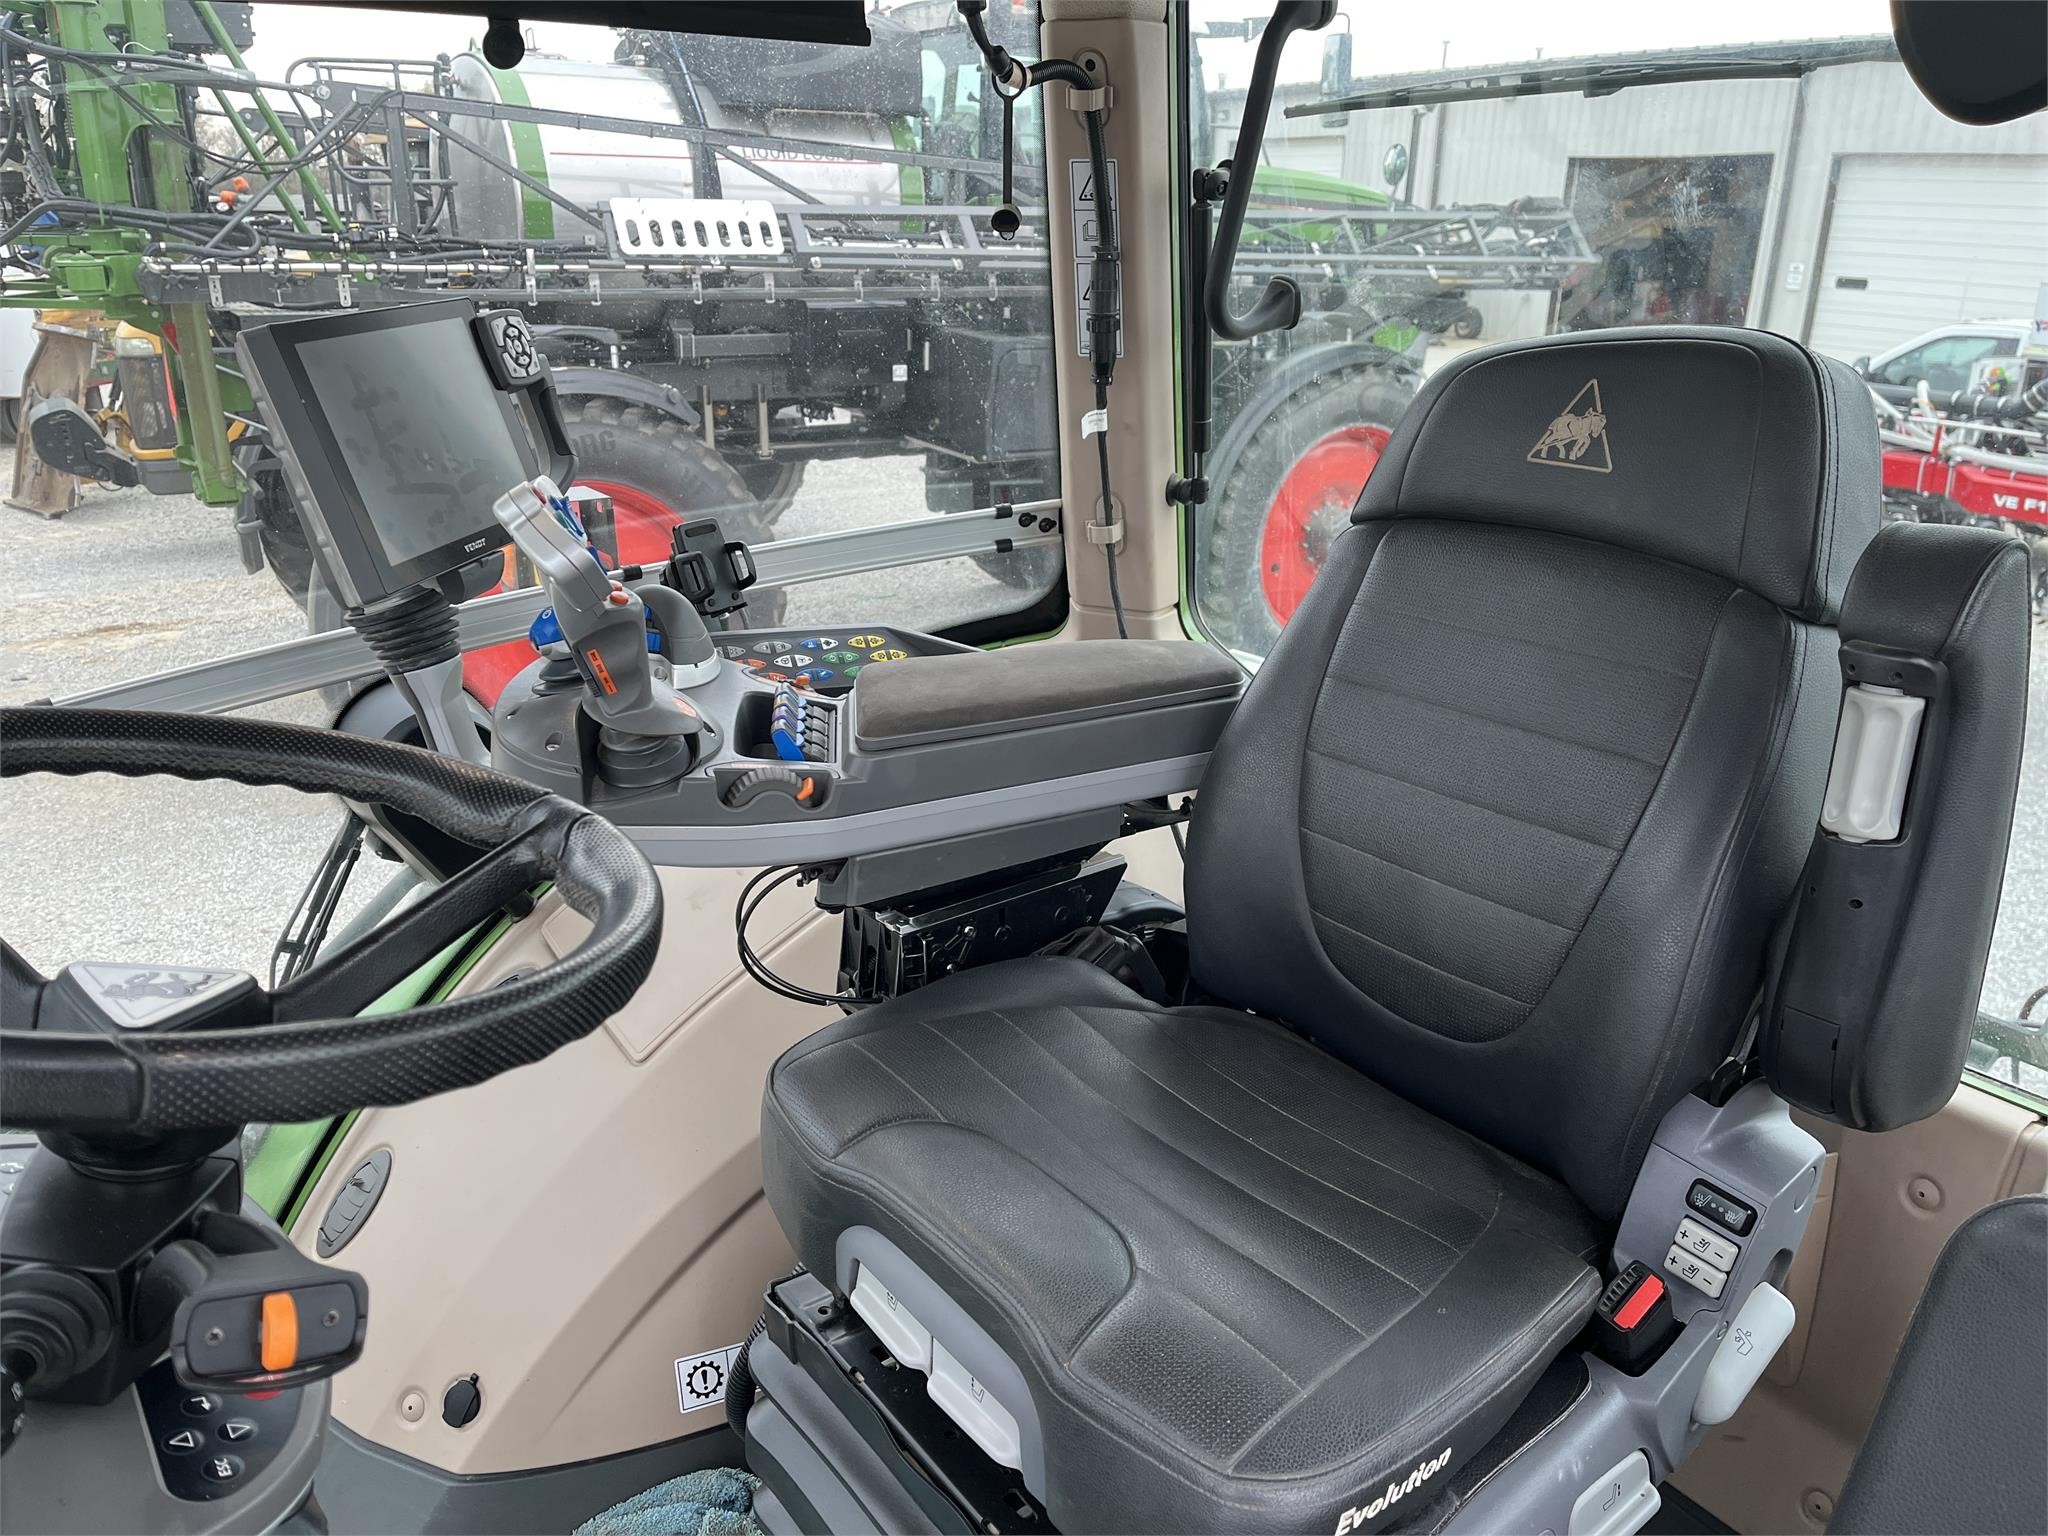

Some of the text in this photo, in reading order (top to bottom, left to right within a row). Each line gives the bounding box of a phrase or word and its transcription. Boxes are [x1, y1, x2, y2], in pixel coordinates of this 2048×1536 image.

[1992, 493, 2019, 510] VE
[214, 1457, 233, 1478] ESC
[1335, 1447, 1452, 1536] Evolution
